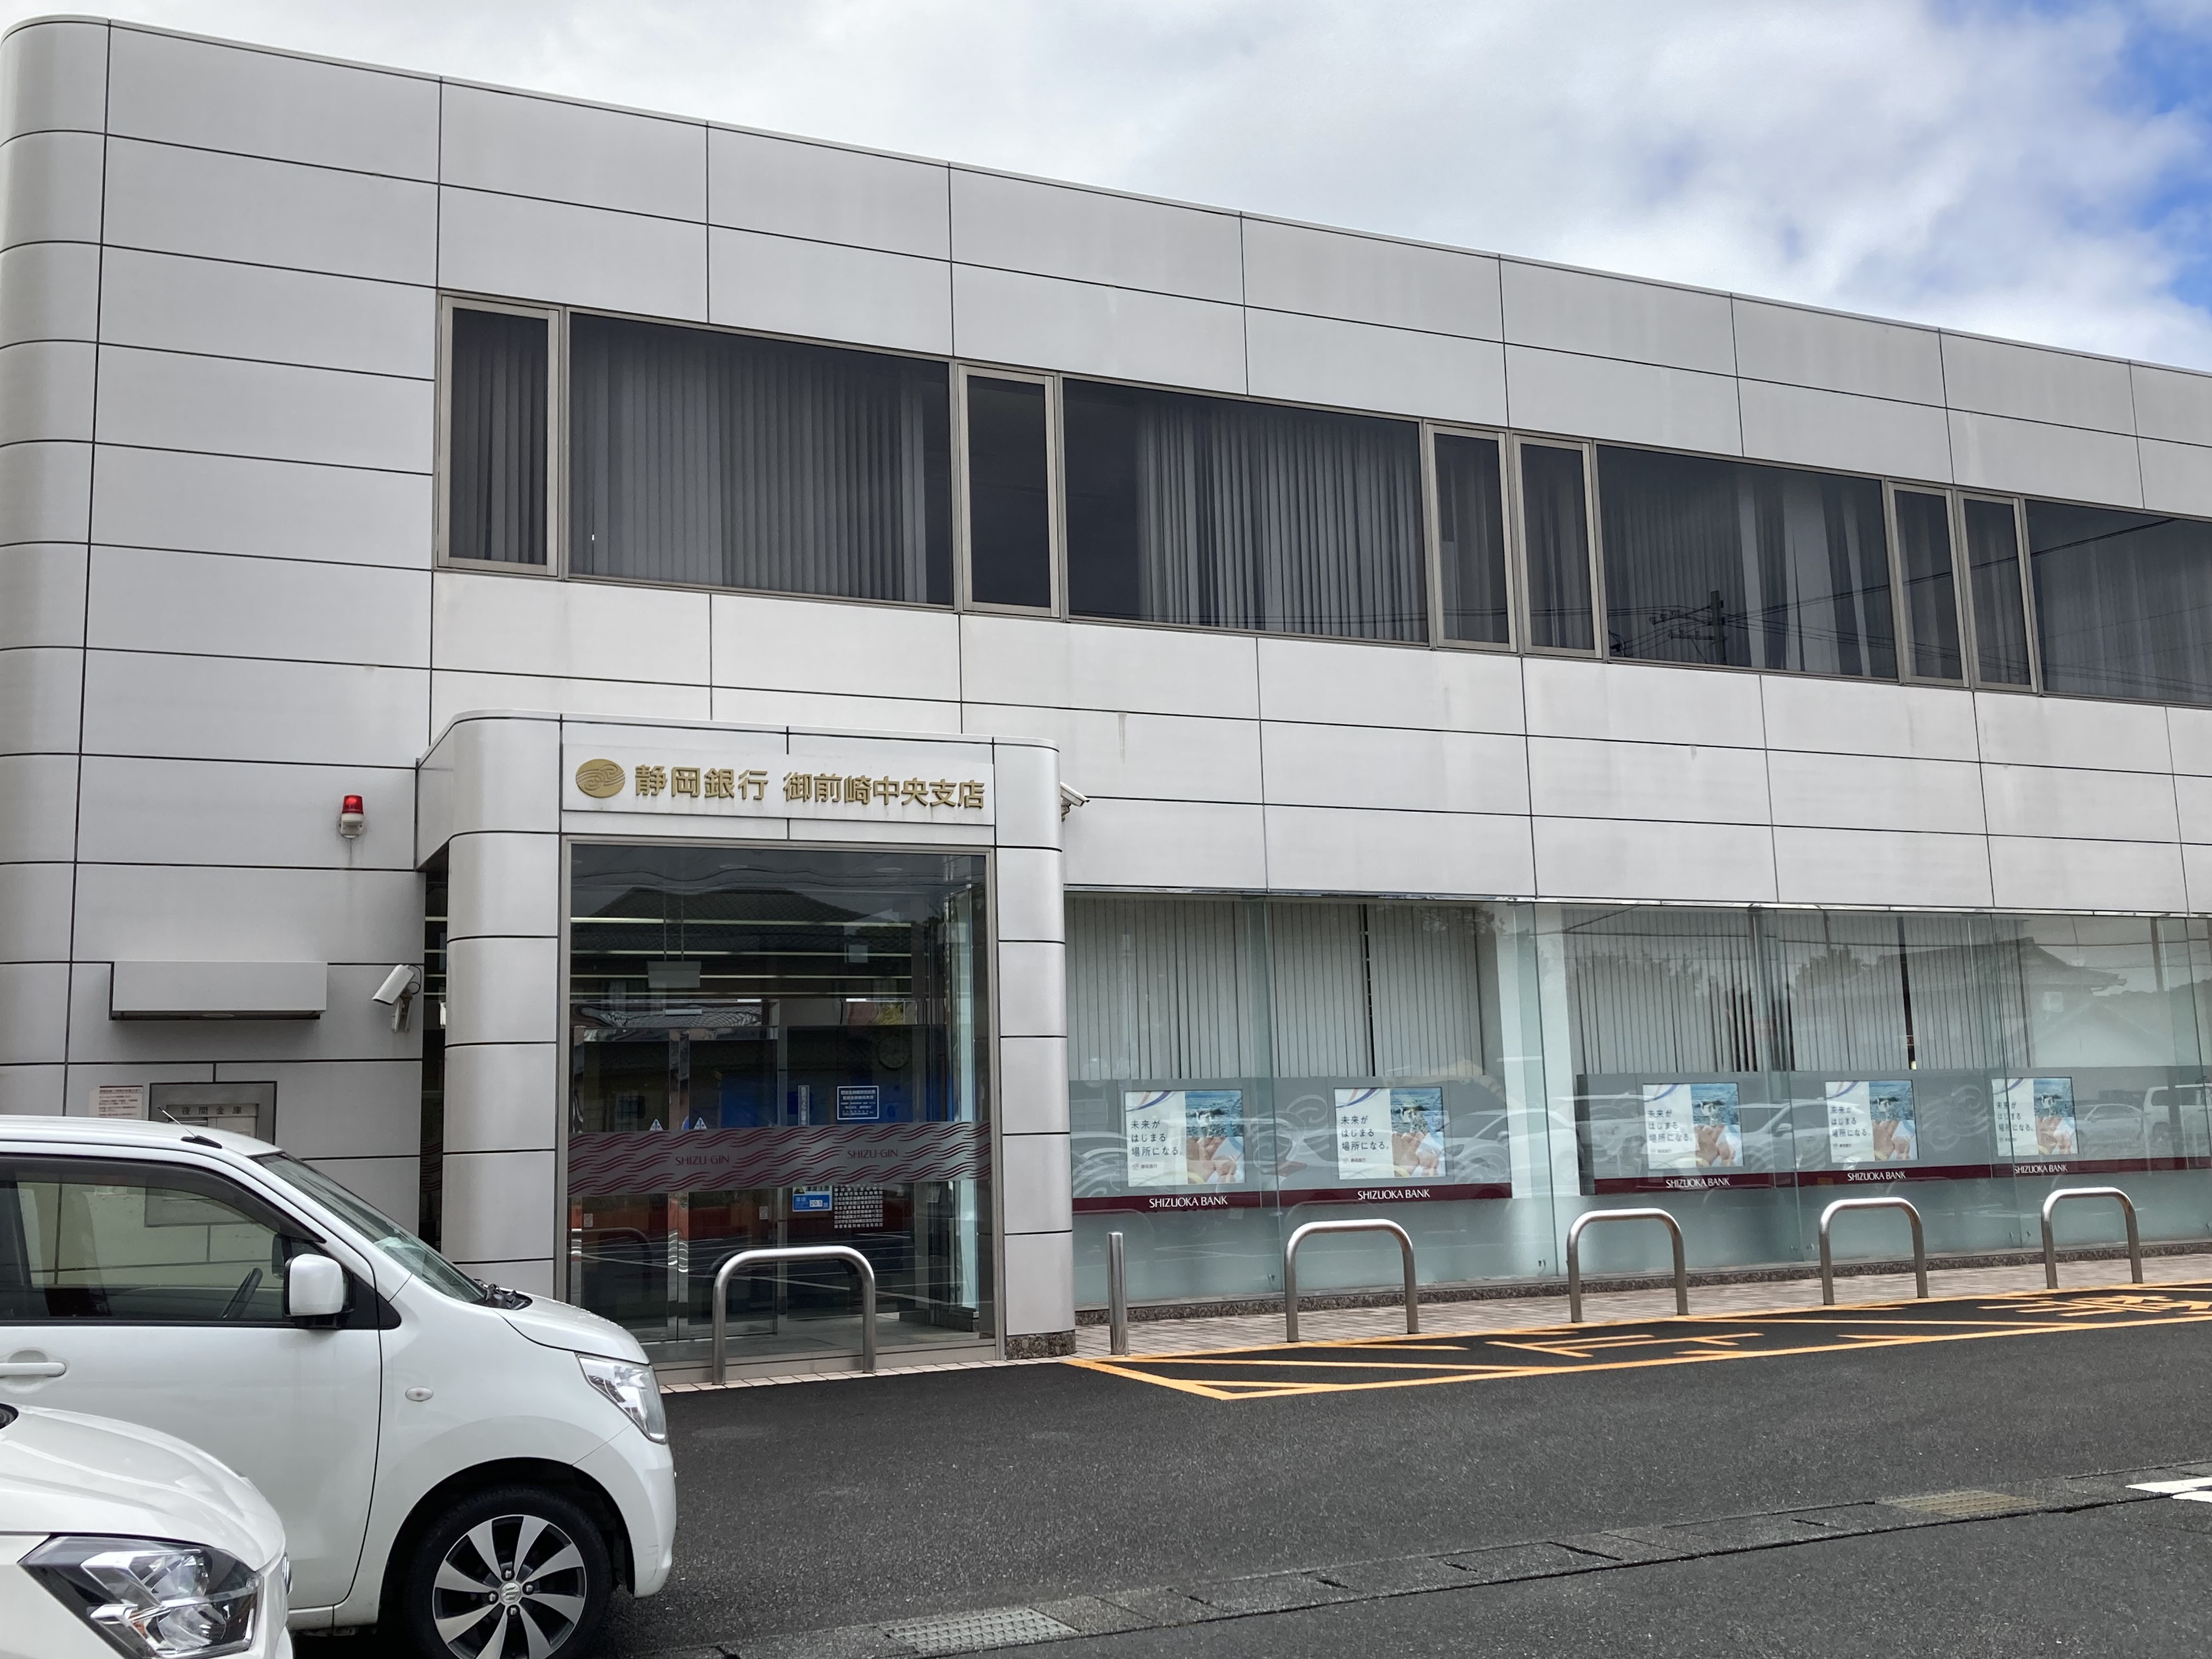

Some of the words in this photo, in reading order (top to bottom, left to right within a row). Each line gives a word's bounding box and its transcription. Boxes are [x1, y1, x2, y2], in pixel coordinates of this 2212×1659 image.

[635, 764, 768, 799] 静岡銀行
[782, 770, 985, 809] 御前崎中央支店
[181, 1105, 242, 1115] 夜間金庫
[1647, 1109, 1672, 1118] 未来が
[1830, 1106, 1852, 1114] 未来が
[1131, 1119, 1160, 1129] 未来が
[1341, 1115, 1368, 1125] 未来が
[1831, 1117, 1857, 1125] はじまる
[1341, 1128, 1374, 1137] はじまる
[1131, 1133, 1166, 1143] はじまる
[1342, 1141, 1389, 1151] 場所になる。
[1131, 1147, 1183, 1156] 場所になる。
[2015, 1165, 2049, 1174] SHIZUOKA
[2049, 1164, 2068, 1172] BANK
[1847, 1172, 1885, 1181] SHIZUOKA
[1886, 1171, 1906, 1180] BANK
[1666, 1178, 1707, 1188] SHIZUOKA
[1708, 1177, 1730, 1187] BANK
[1357, 1189, 1404, 1200] SHIZUOKA
[1405, 1189, 1431, 1199] BANK
[1149, 1197, 1199, 1208] SHIZUOKA
[1201, 1195, 1228, 1206] BANK
